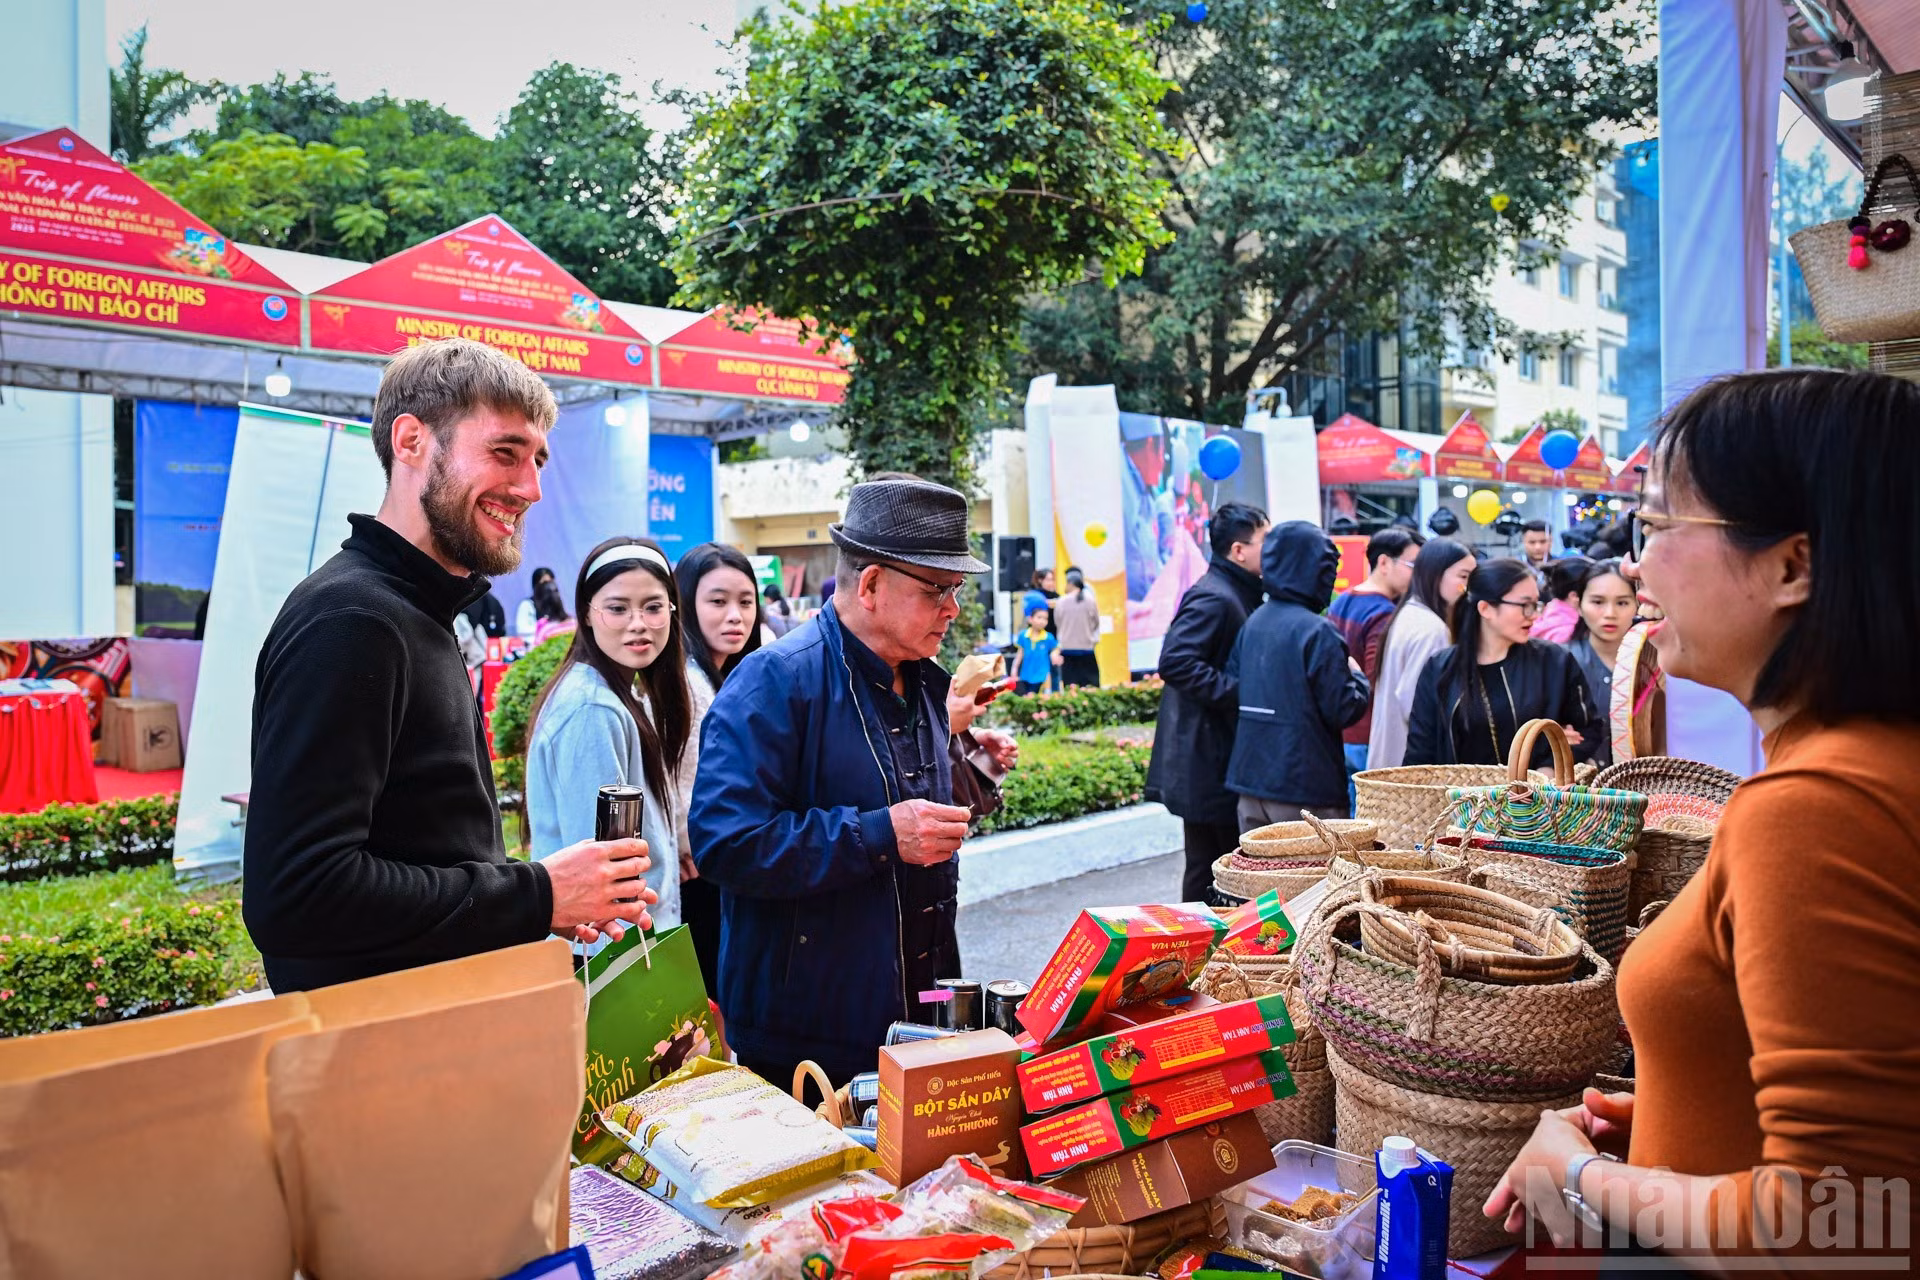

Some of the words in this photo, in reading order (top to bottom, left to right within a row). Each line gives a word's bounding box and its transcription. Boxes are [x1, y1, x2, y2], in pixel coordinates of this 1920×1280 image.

[62, 180, 84, 199] of
[12, 262, 44, 284] OF
[47, 266, 134, 296] FOREIGN
[135, 280, 207, 306] AFFAIRS
[60, 290, 95, 313] TIN
[99, 295, 142, 319] BÁO
[144, 300, 179, 324] CHÍ
[396, 317, 461, 337] MINISTRY
[462, 324, 483, 343] OF
[484, 327, 541, 348] FOREIGN
[1064, 966, 1083, 989] ANH
[913, 1098, 945, 1119] BỘT
[982, 1086, 1012, 1104] DÂY
[1068, 1142, 1089, 1157] ANH
[1378, 1198, 1391, 1263] Vinamilk
